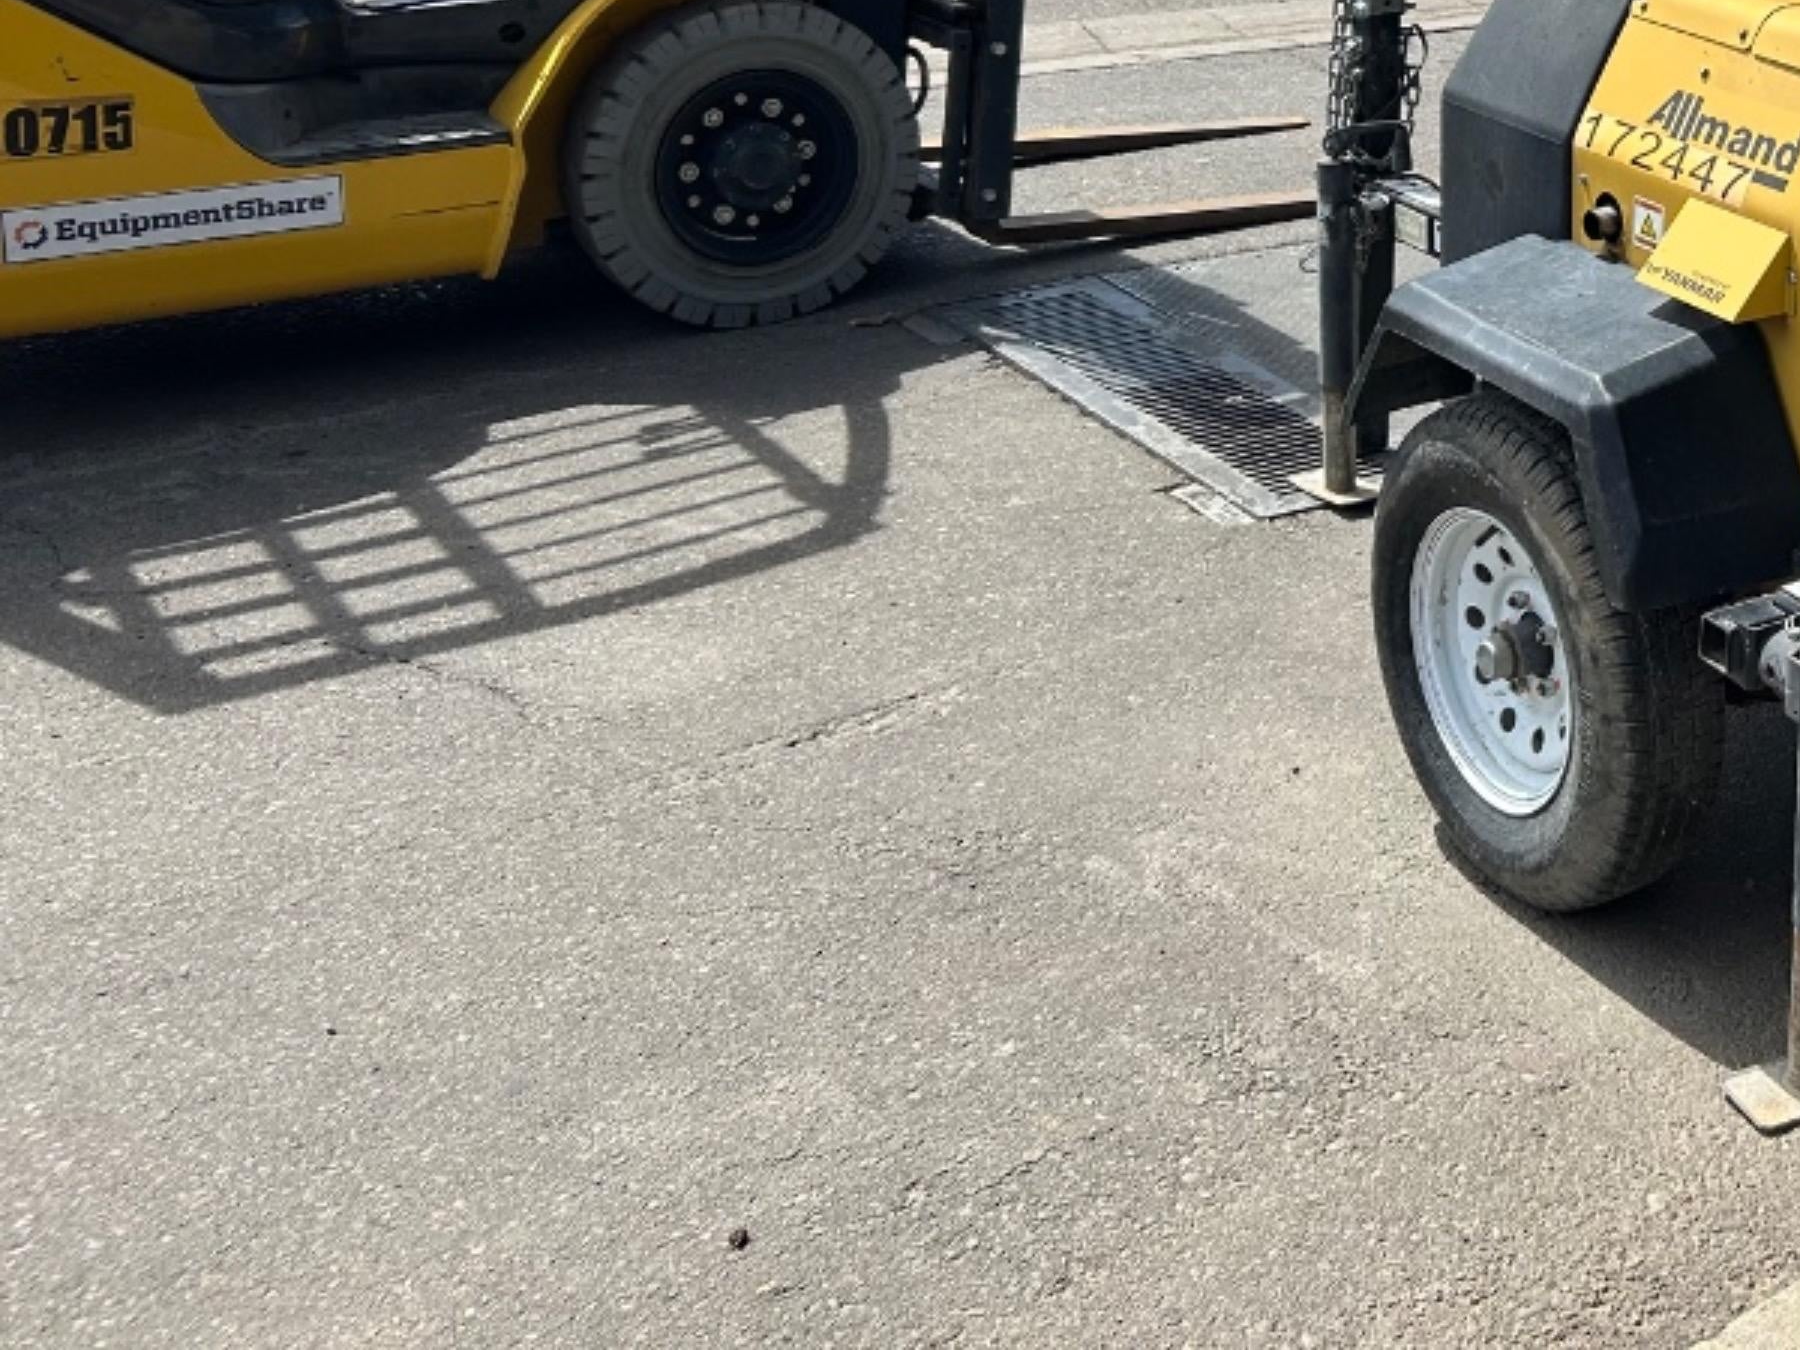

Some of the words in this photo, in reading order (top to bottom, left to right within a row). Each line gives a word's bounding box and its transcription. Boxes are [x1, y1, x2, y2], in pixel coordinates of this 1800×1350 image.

[5, 103, 133, 156] 0715
[1586, 113, 1750, 200] 172447
[54, 194, 328, 243] EquipmentShare
